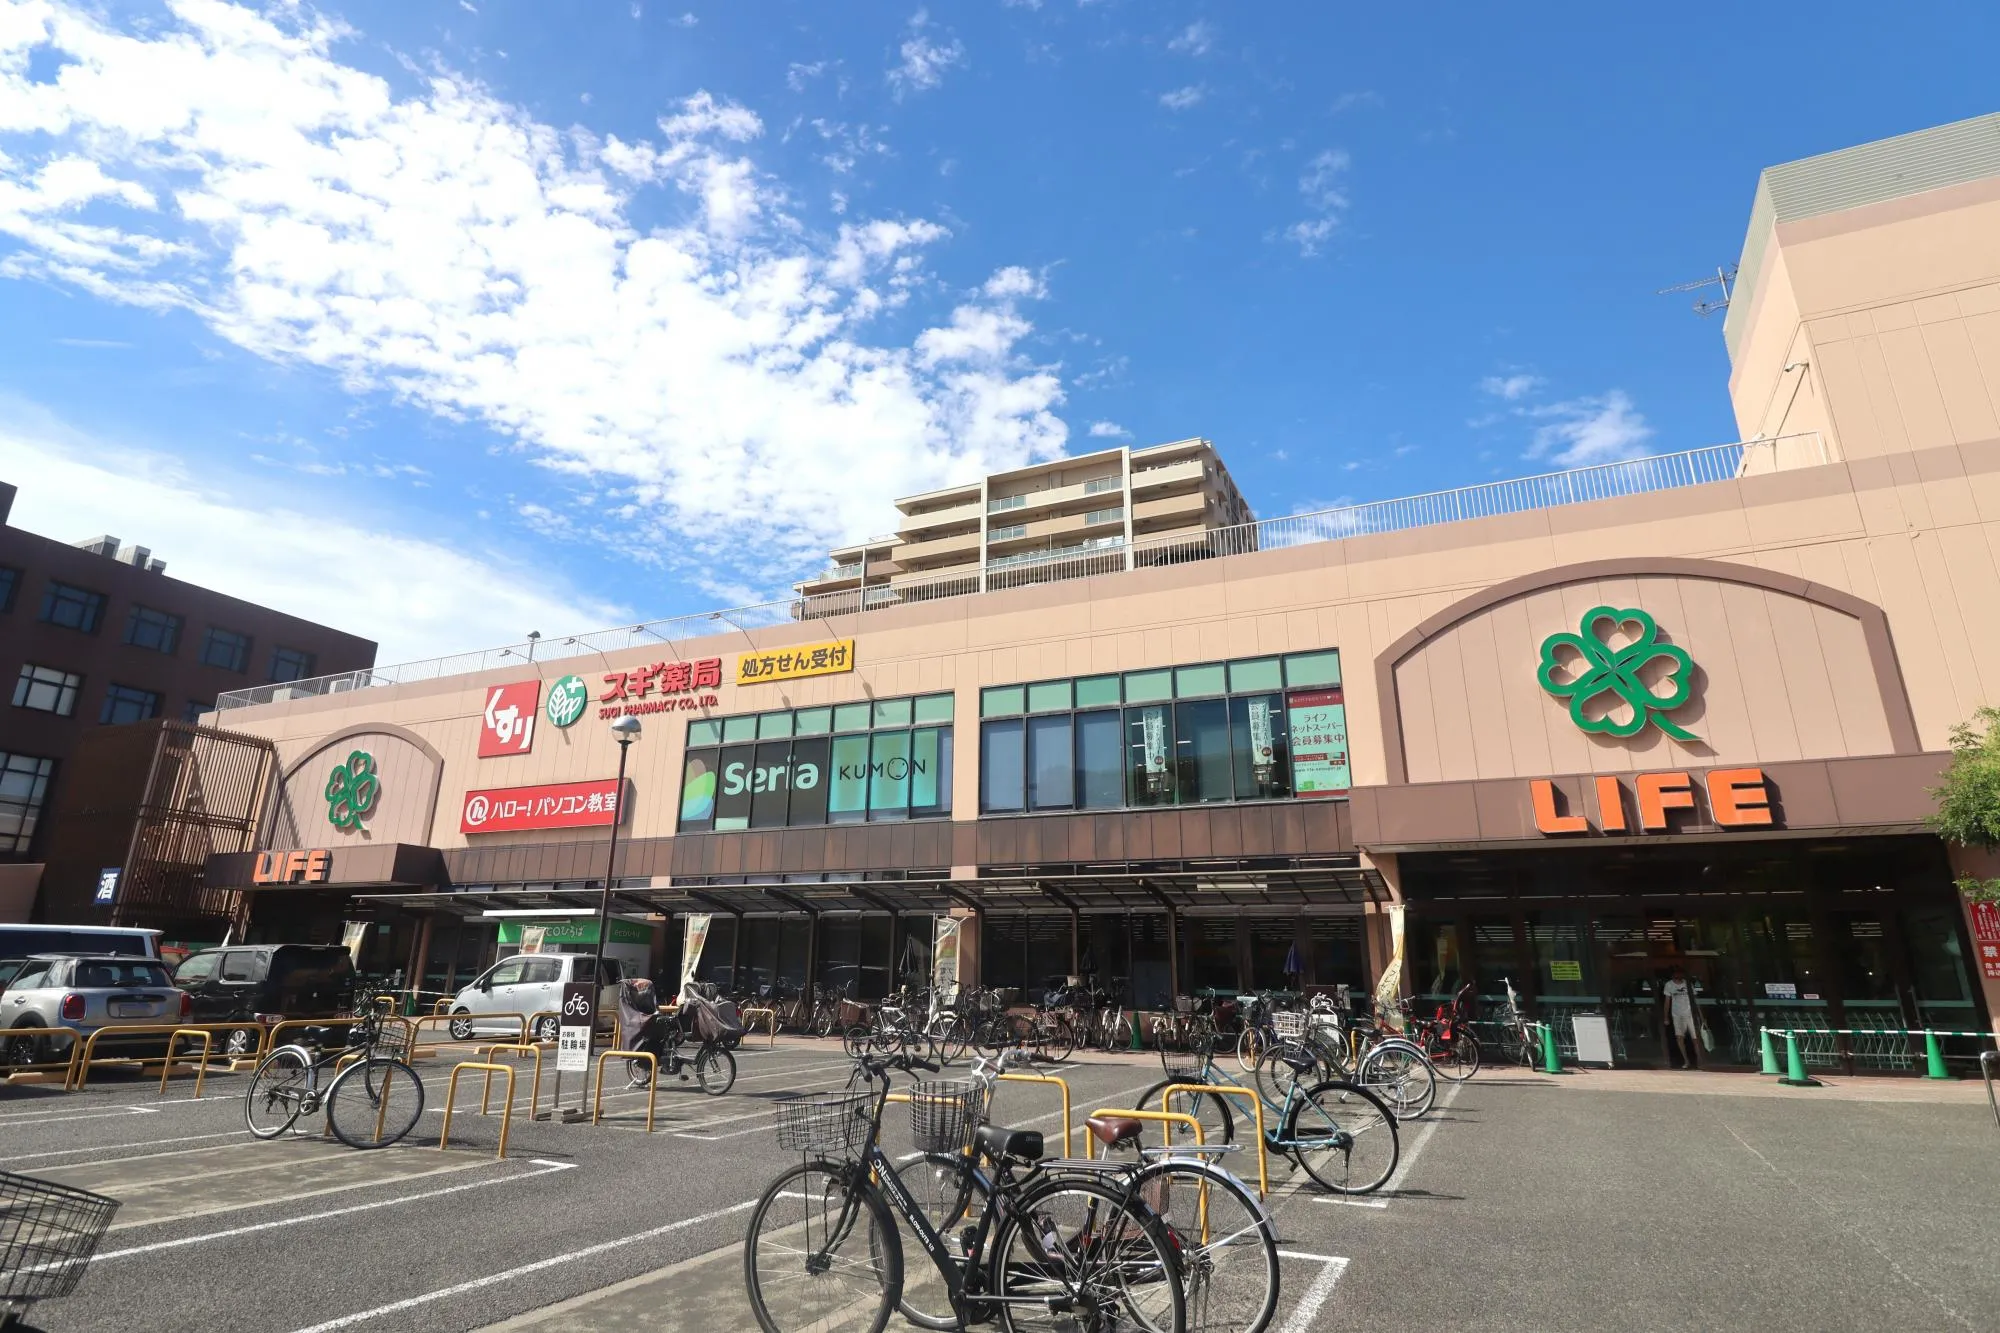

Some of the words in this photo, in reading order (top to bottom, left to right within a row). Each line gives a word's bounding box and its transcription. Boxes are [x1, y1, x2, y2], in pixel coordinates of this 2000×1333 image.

[742, 646, 847, 679] 処方せん受付
[600, 658, 721, 703] スギ薬局
[484, 688, 534, 749] くすり
[599, 704, 621, 720] SUGI
[624, 701, 675, 717] PHARMACY
[1303, 713, 1328, 723] ライフ
[1292, 721, 1344, 734] ネットスーパー
[1292, 733, 1345, 747] 会員募集中
[724, 754, 818, 796] Seria
[839, 757, 926, 780] KUMON
[1529, 768, 1773, 834] LIFE
[253, 850, 328, 883] LIFE
[98, 873, 118, 900] 酒
[561, 1039, 587, 1050] 駐輪場
